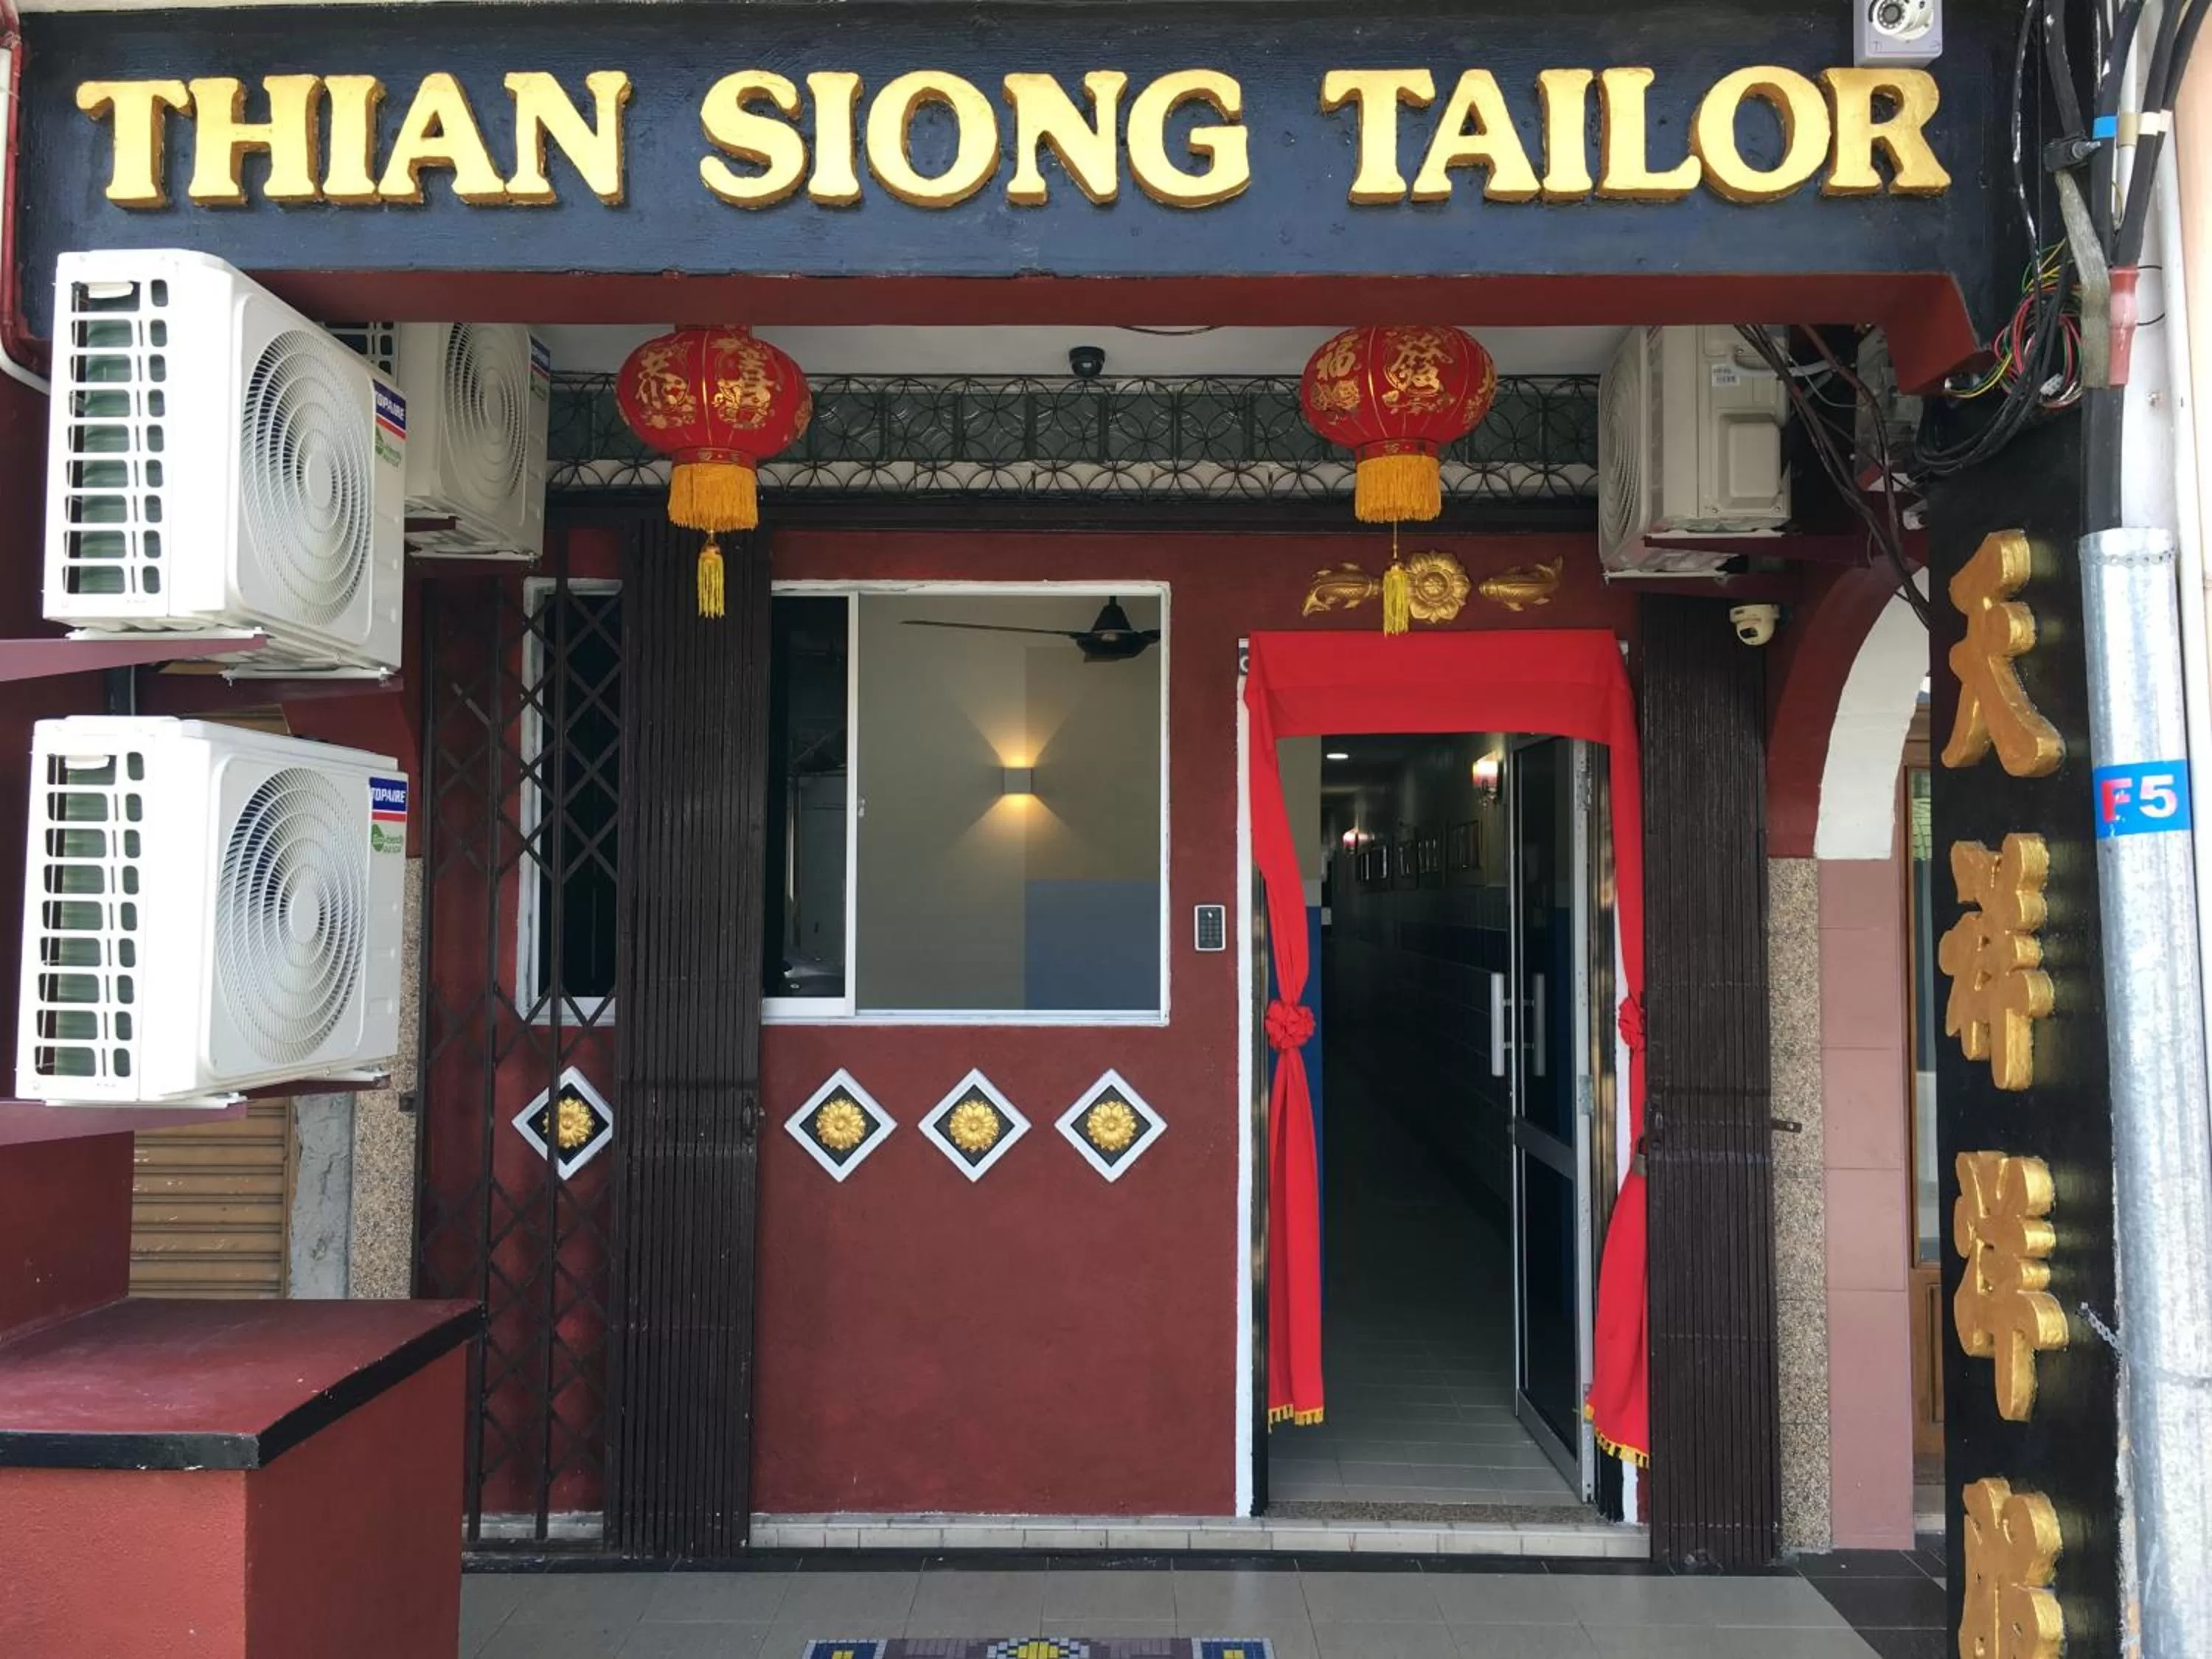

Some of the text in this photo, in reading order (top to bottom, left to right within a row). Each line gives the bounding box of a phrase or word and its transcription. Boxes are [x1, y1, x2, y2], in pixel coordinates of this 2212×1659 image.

[76, 66, 1952, 209] THIAN SIONG TAILOR
